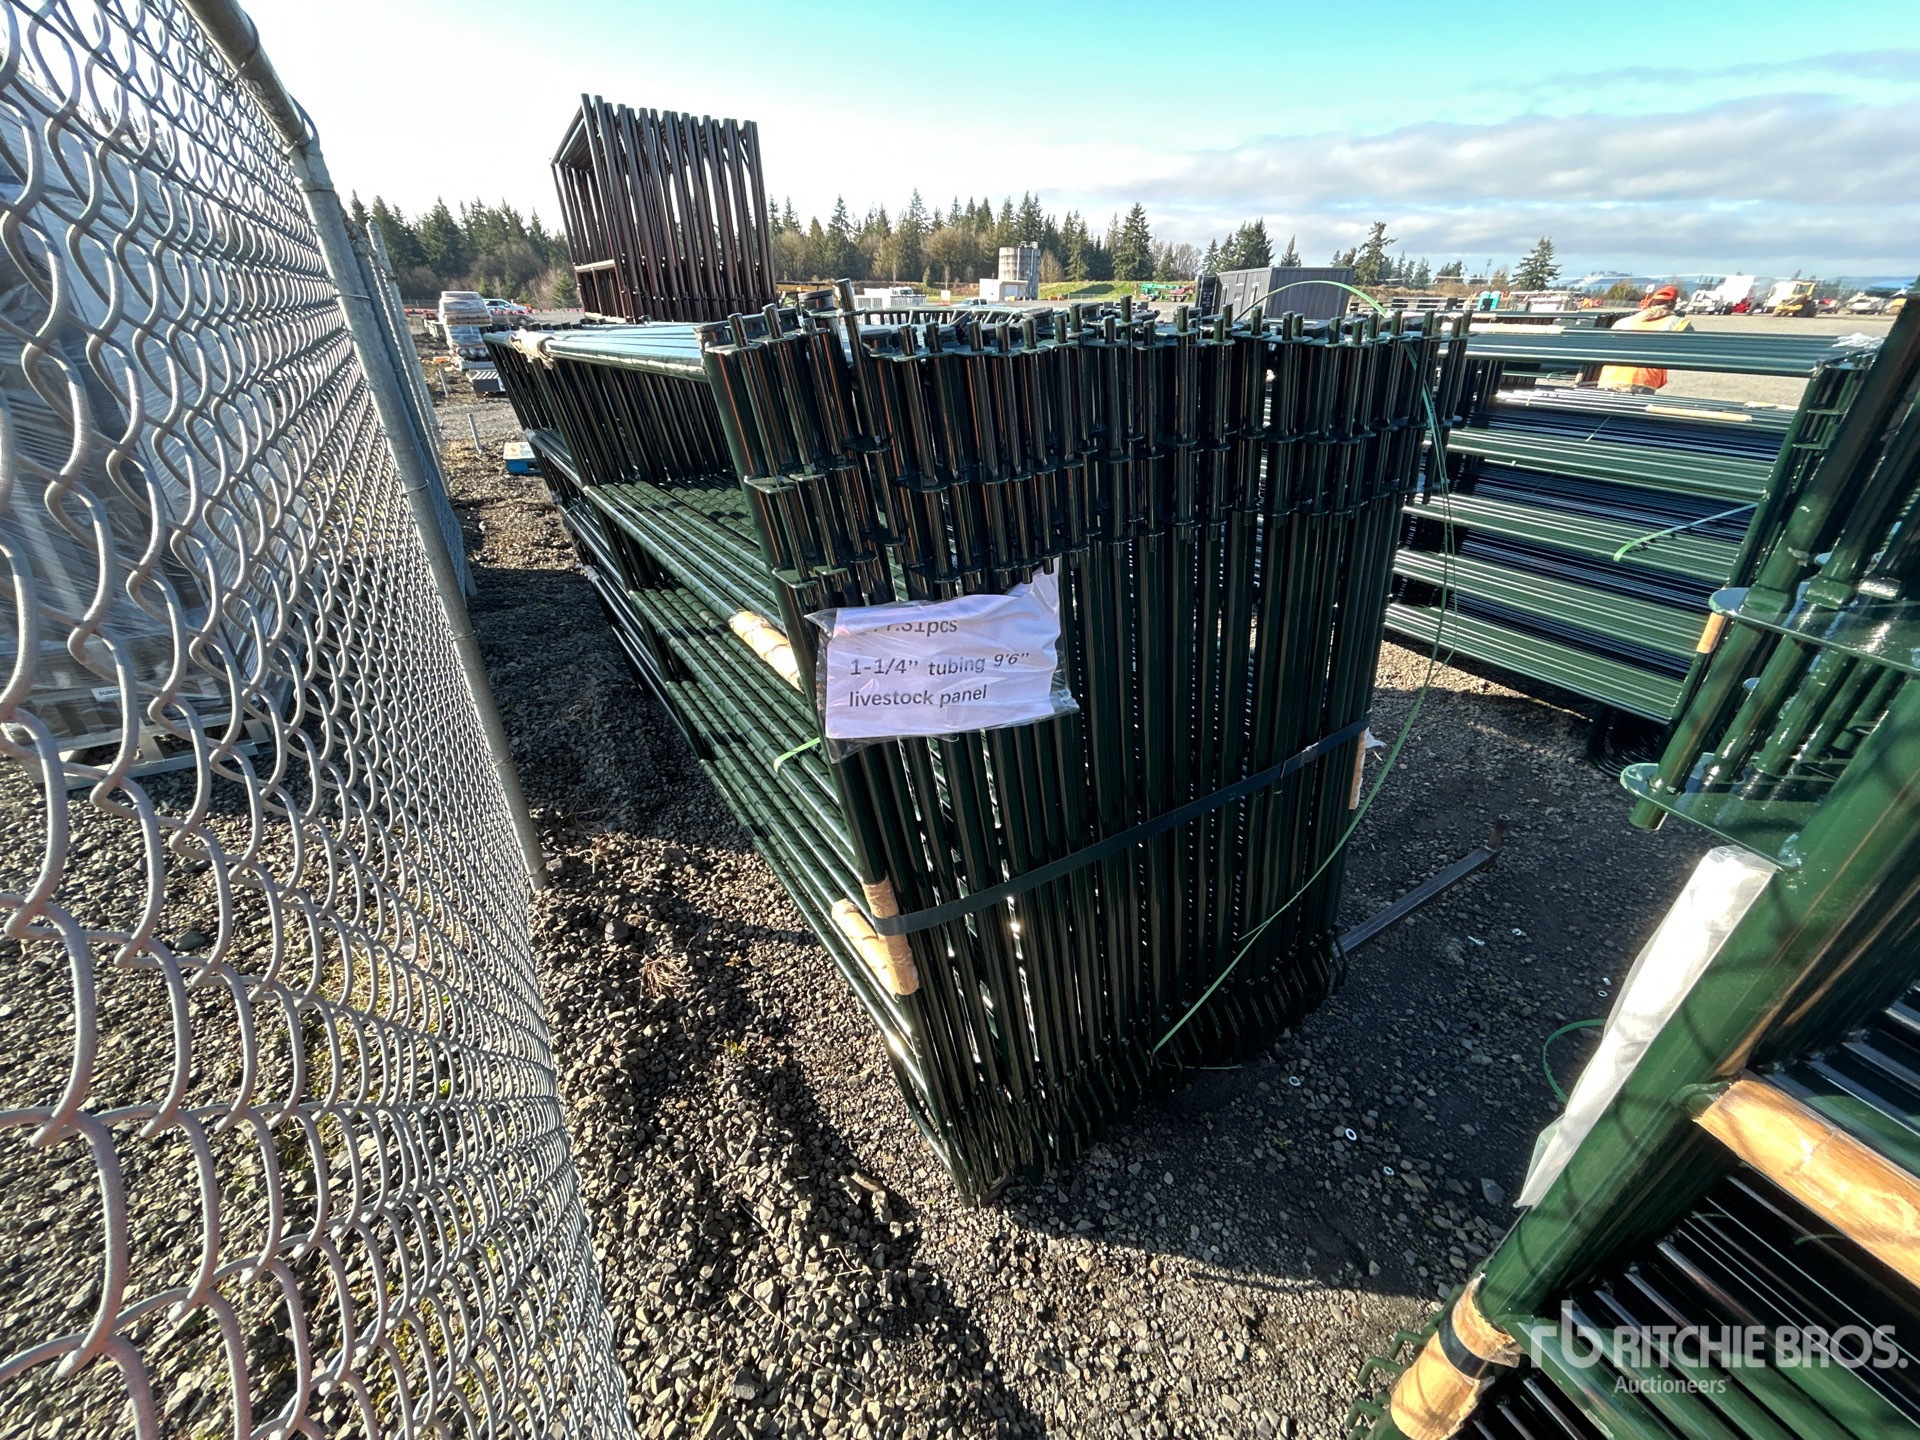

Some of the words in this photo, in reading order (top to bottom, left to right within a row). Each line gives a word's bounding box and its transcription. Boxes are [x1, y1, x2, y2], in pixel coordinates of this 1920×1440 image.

[928, 657, 986, 675] tubing
[849, 690, 934, 707] livestock
[939, 684, 987, 708] panel
